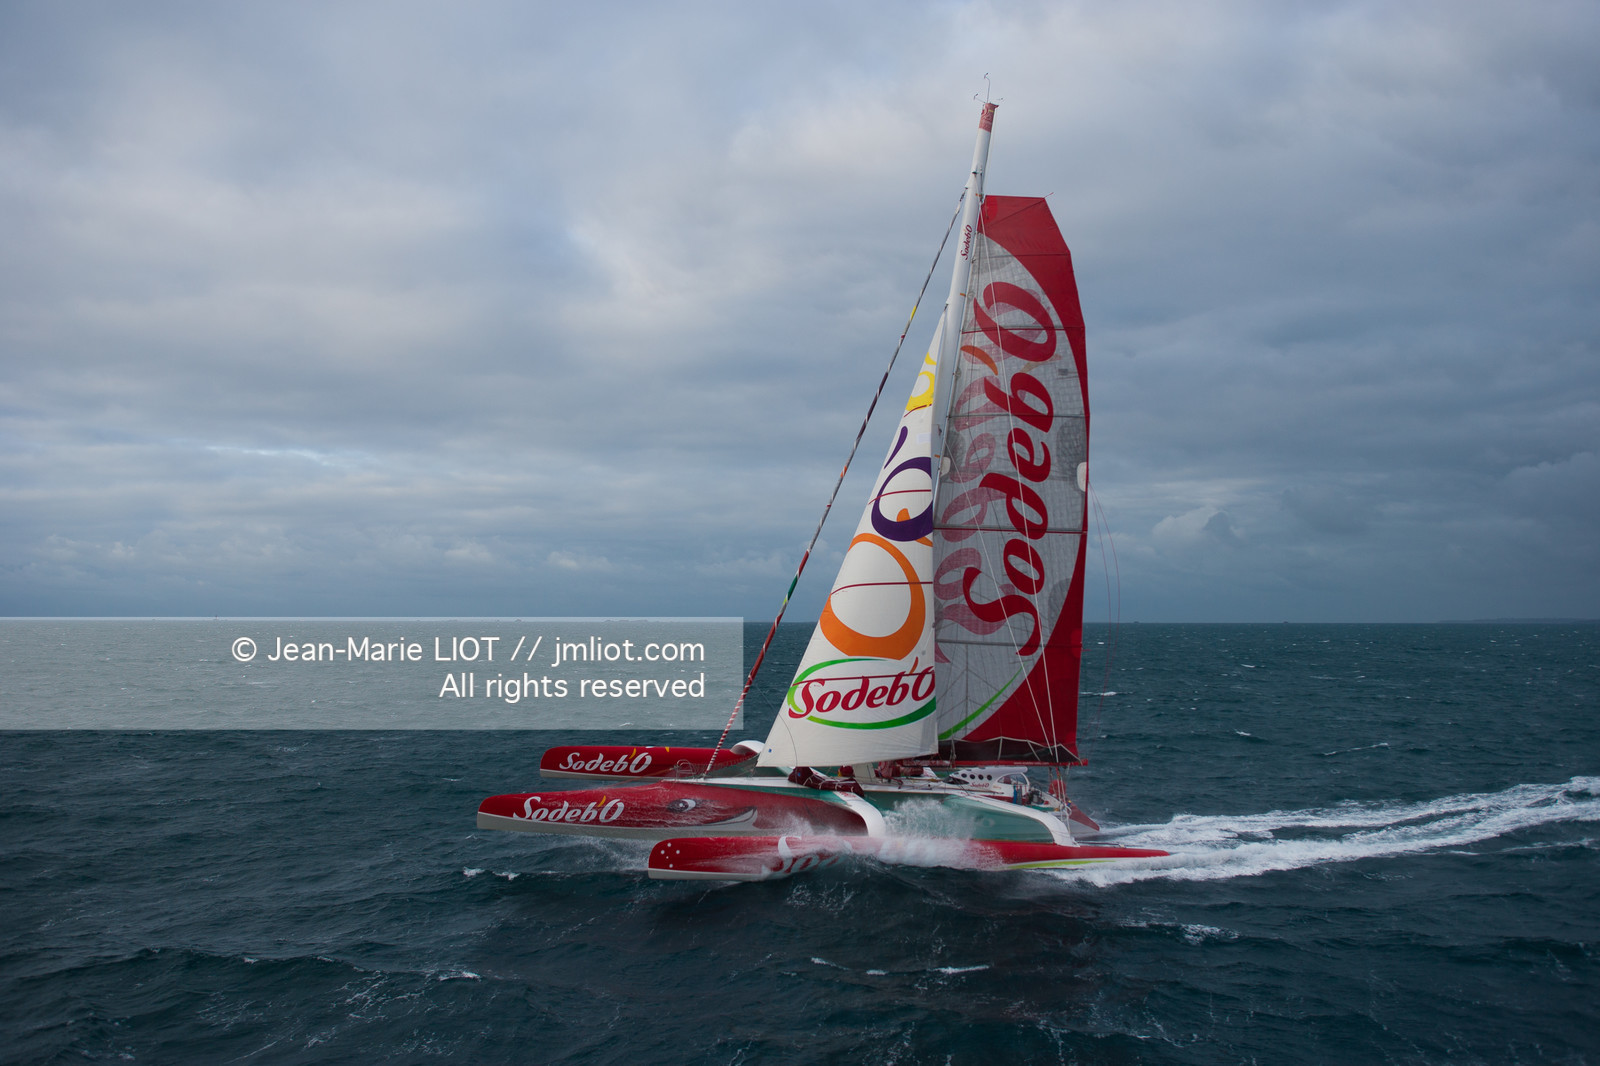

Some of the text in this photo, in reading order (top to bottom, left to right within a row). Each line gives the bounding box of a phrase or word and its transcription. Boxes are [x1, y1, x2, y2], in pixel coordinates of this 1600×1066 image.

[960, 281, 1057, 657] Sodeb'O
[788, 656, 936, 719] Sodeb'O
[559, 748, 652, 774] Sodeb'O
[512, 795, 625, 823] Sodeb'O
